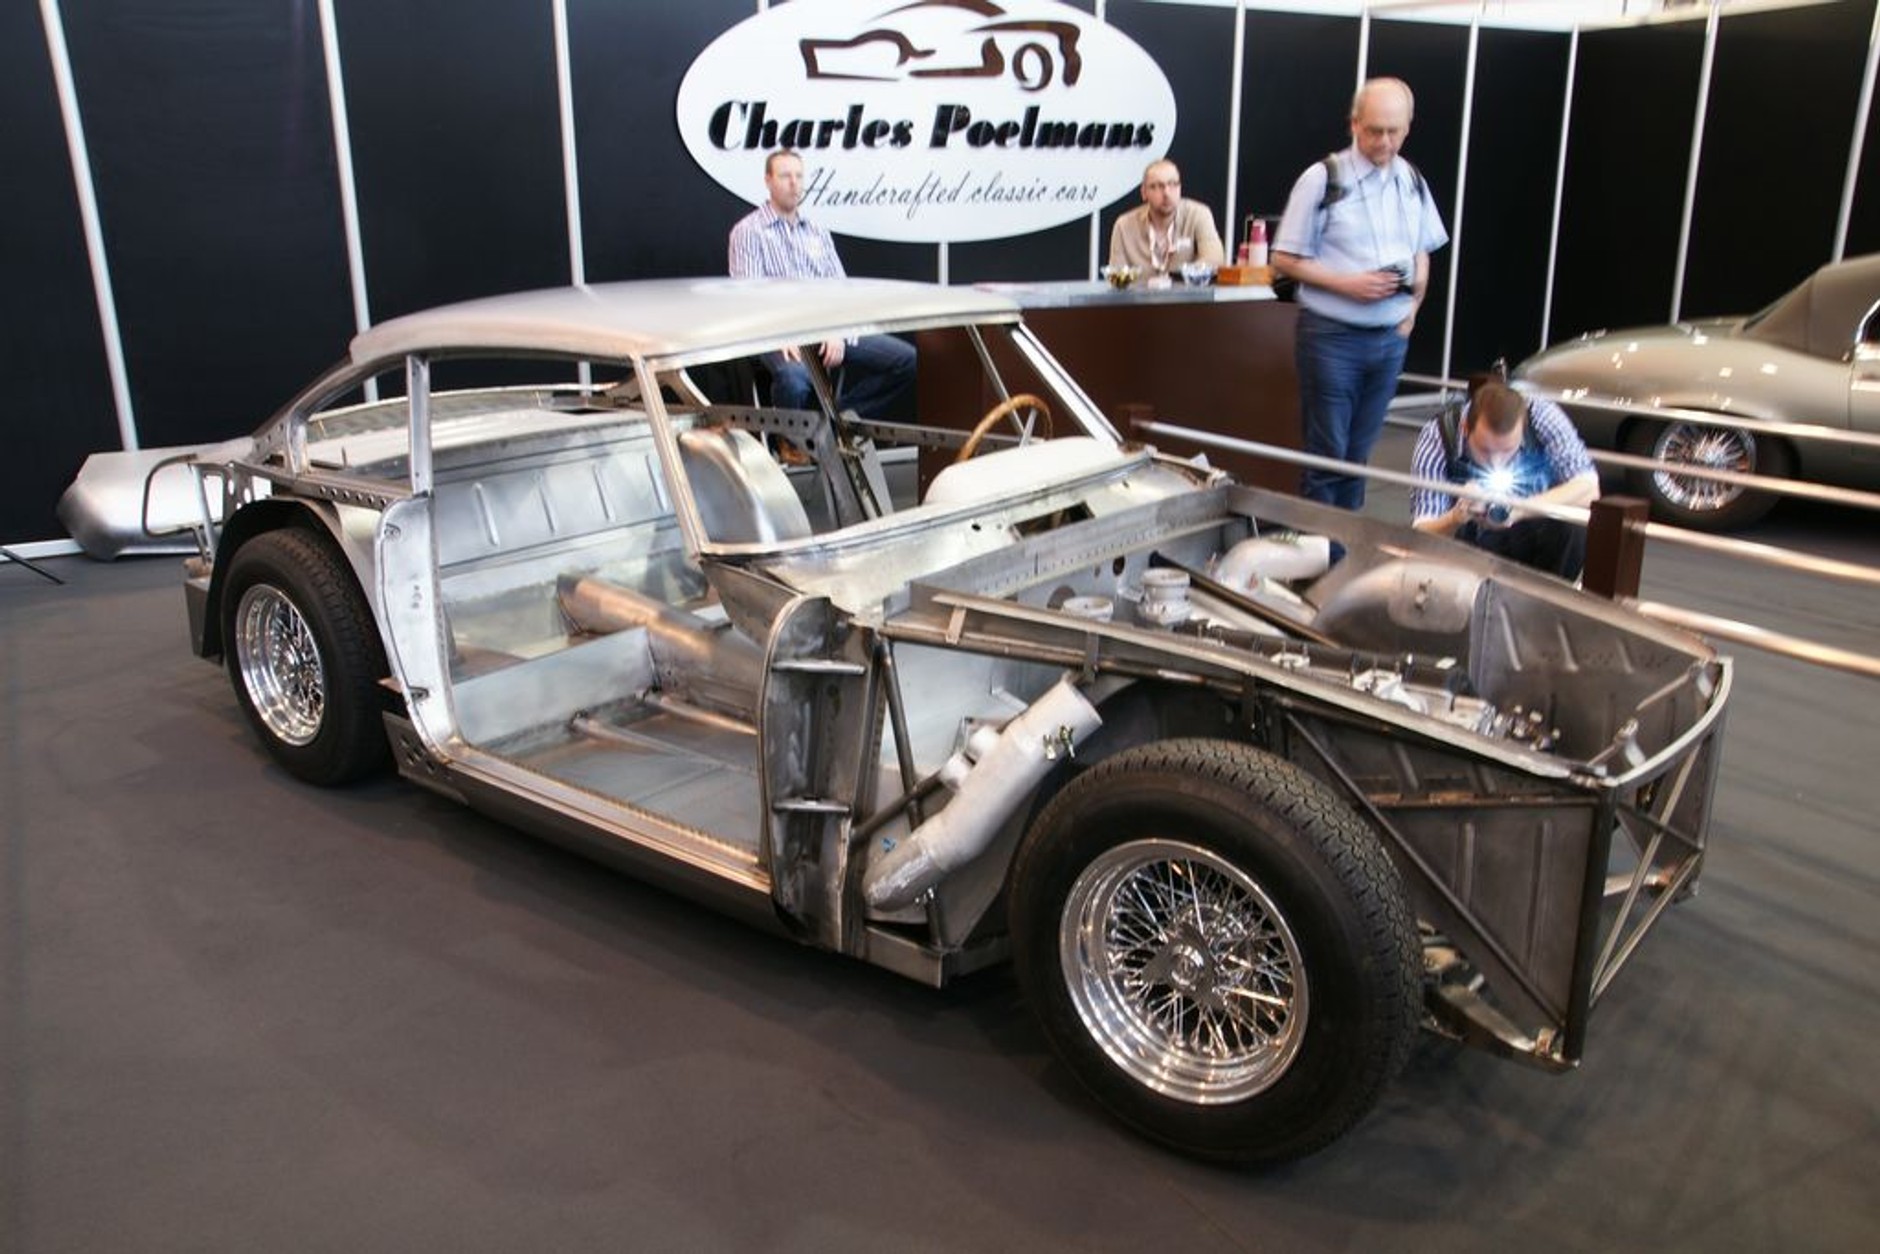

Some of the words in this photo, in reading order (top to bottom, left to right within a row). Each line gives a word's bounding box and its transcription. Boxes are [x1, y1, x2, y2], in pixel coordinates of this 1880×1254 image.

[708, 100, 913, 151] Charles
[929, 103, 1155, 149] Poelmans
[799, 167, 969, 221] Handcrafted
[969, 171, 1048, 203] classic
[1054, 182, 1099, 203] cars
